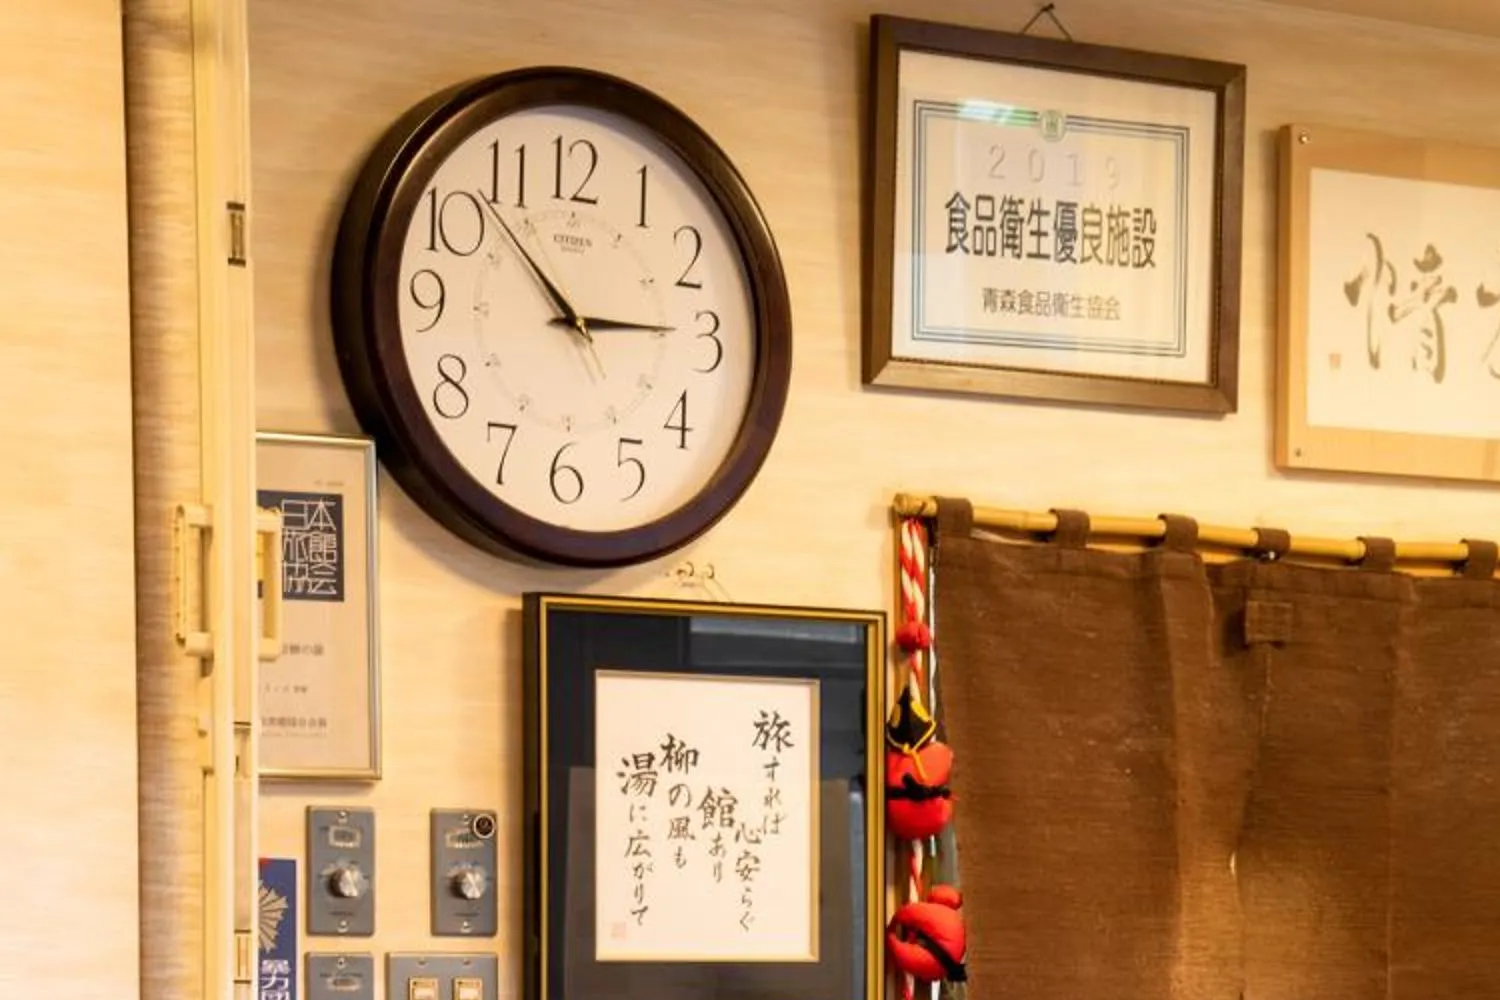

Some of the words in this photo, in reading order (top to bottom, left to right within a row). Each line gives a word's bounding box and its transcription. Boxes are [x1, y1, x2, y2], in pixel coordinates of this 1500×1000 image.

[487, 139, 526, 208] 11
[551, 135, 598, 205] 12
[636, 165, 650, 228] 1
[987, 144, 1121, 191] 2019
[427, 187, 485, 256] 10
[944, 191, 1157, 269] 食品衛生優良施設
[674, 225, 702, 289] 2
[410, 269, 445, 333] 9
[982, 287, 1121, 321] 青森食品衛生協会
[694, 311, 723, 373] 3
[432, 354, 469, 419] 8
[663, 389, 694, 450] 4
[486, 422, 517, 485] 7
[550, 442, 584, 504] 6
[617, 438, 645, 500] 5
